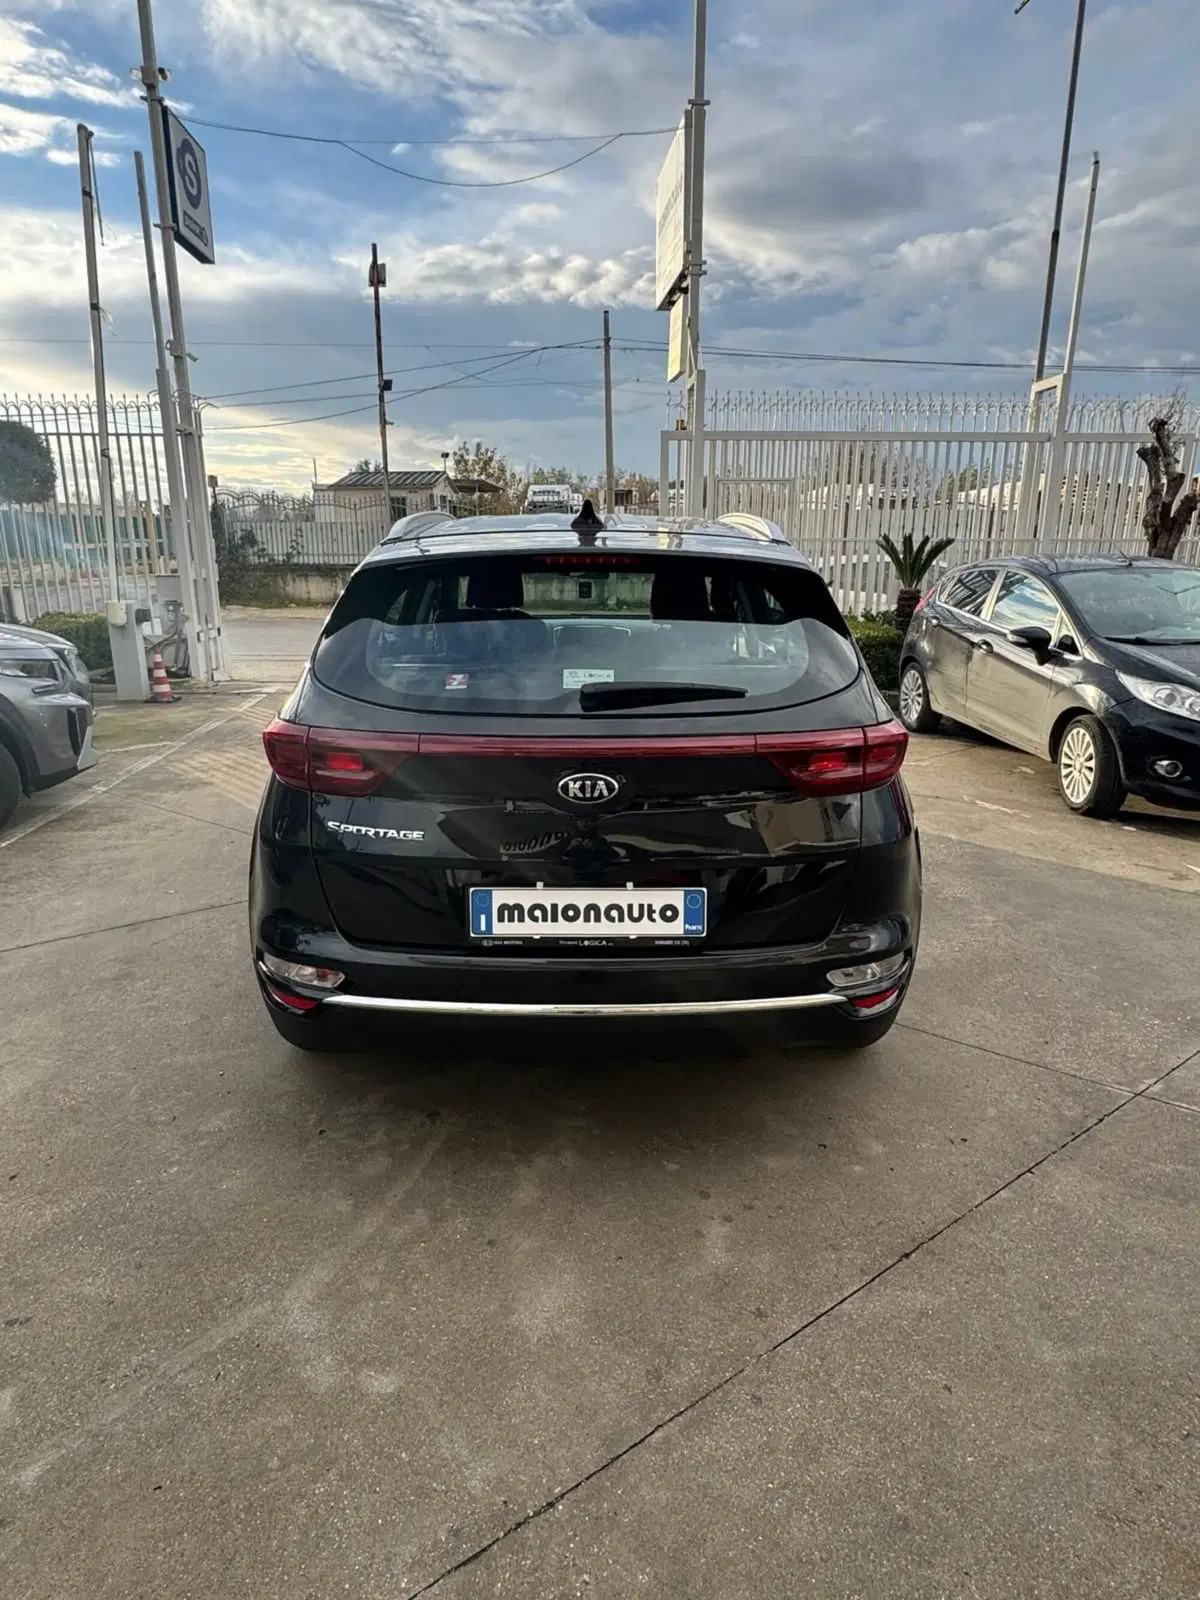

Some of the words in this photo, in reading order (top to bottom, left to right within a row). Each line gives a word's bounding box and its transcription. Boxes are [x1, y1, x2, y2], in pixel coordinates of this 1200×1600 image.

[184, 152, 197, 195] S
[568, 780, 609, 798] KIA
[327, 821, 425, 841] SPORTAGE
